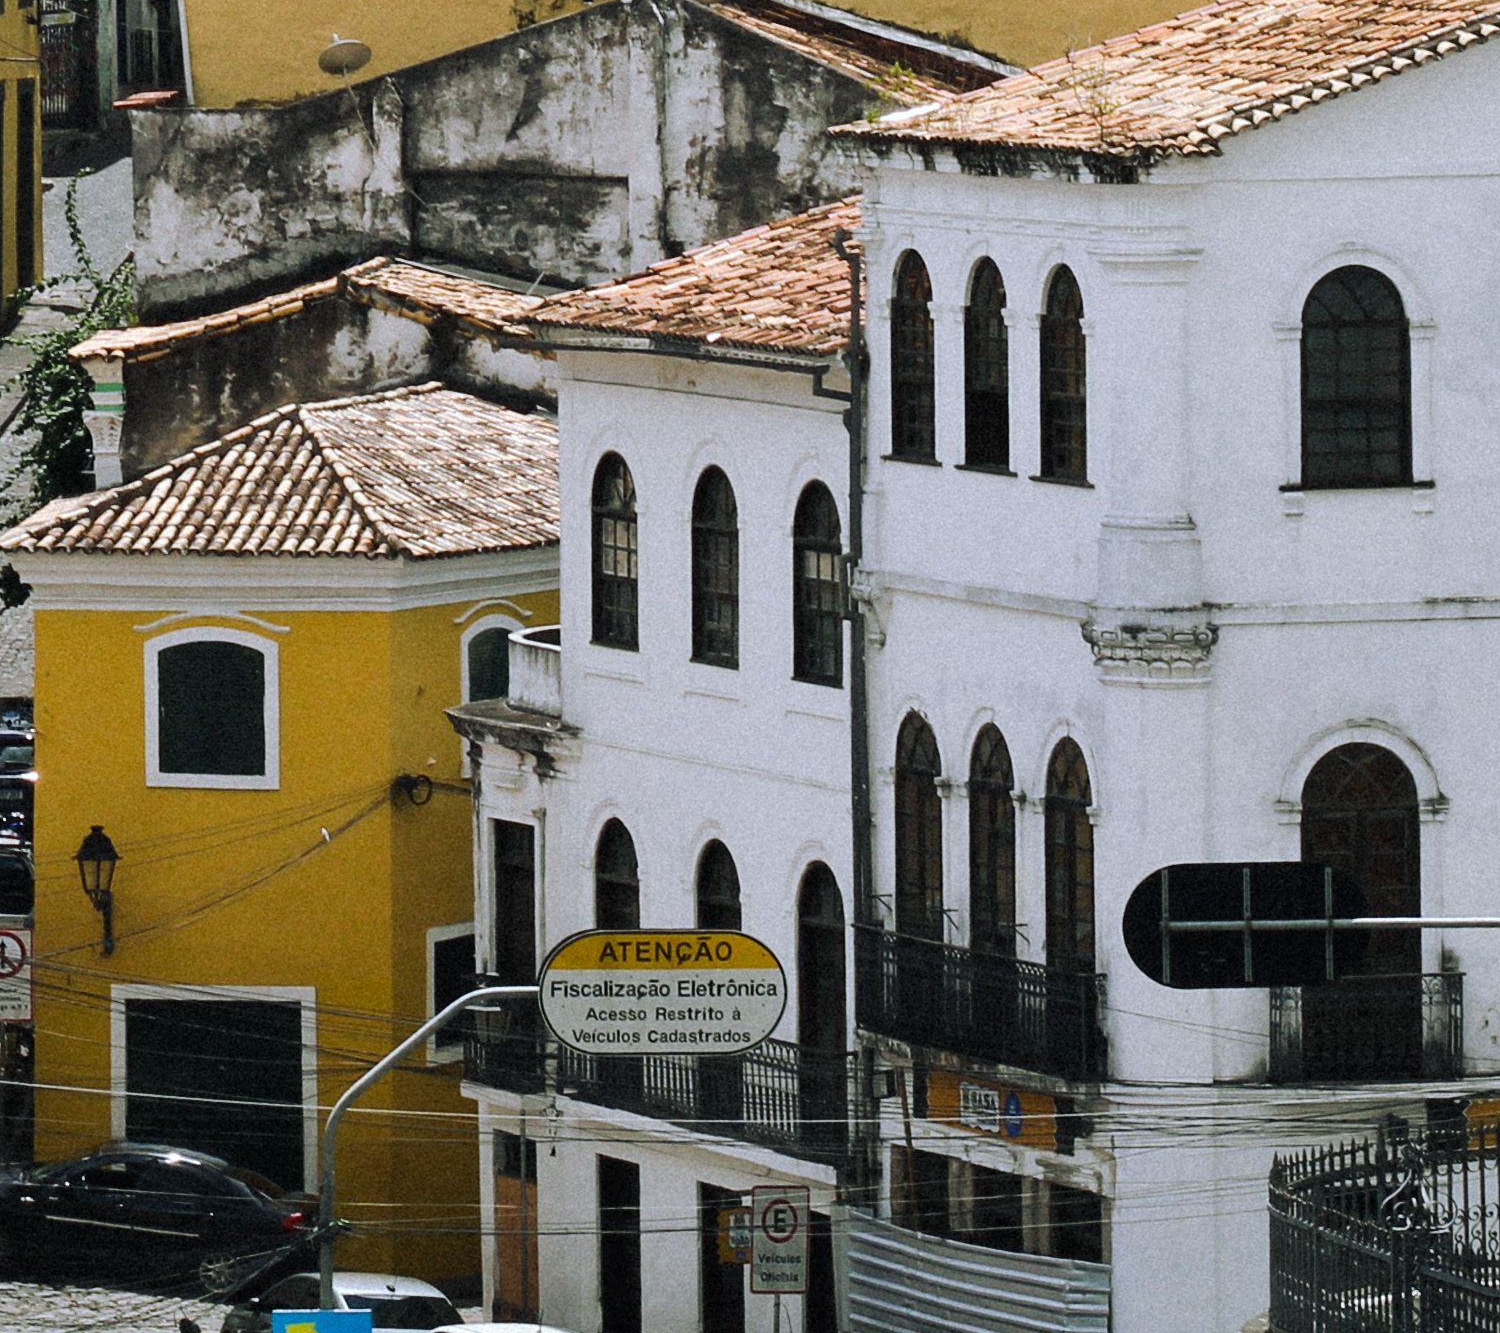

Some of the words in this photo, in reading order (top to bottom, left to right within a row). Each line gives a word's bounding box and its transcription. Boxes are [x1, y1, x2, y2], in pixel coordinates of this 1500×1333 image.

[600, 937, 733, 965] ATENÇÃO
[551, 980, 671, 1000] Fiscalização
[677, 979, 778, 998] Eletrônica
[585, 1007, 647, 1021] Acesso
[655, 1007, 724, 1021] Restrito
[572, 1028, 641, 1045] Veículos
[647, 1027, 751, 1044] Cadastrados
[773, 1208, 788, 1233] E
